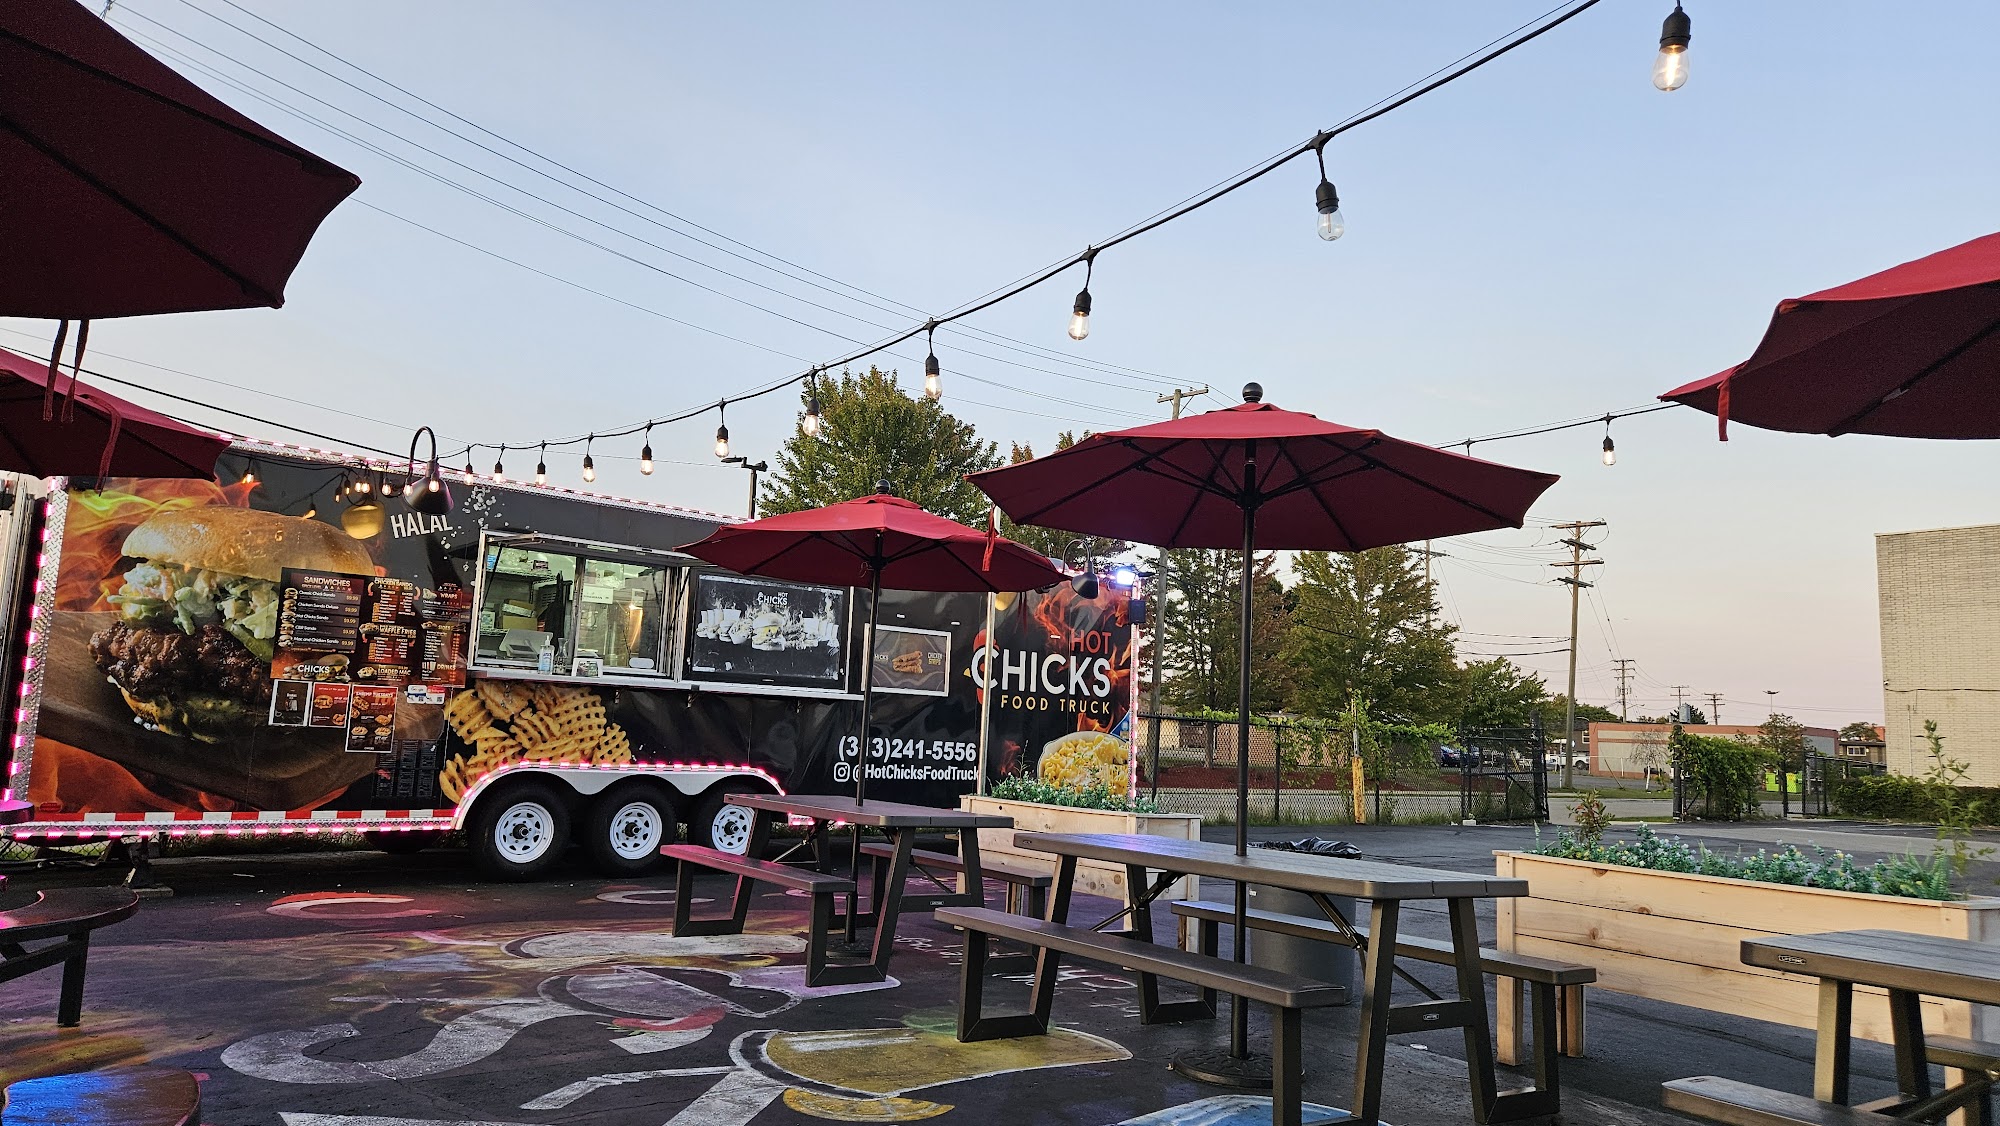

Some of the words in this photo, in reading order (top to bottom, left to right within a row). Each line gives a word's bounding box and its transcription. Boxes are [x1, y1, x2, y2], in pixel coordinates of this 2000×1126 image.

[390, 512, 453, 539] HALAL
[304, 576, 350, 587] SANDWICHES
[758, 594, 788, 606] CHICKS
[1070, 628, 1112, 654] HOT
[298, 665, 330, 673] CHICKS
[971, 646, 1111, 698] CHICKS
[1000, 694, 1048, 710] FOOD
[1060, 698, 1110, 714] TRUCK
